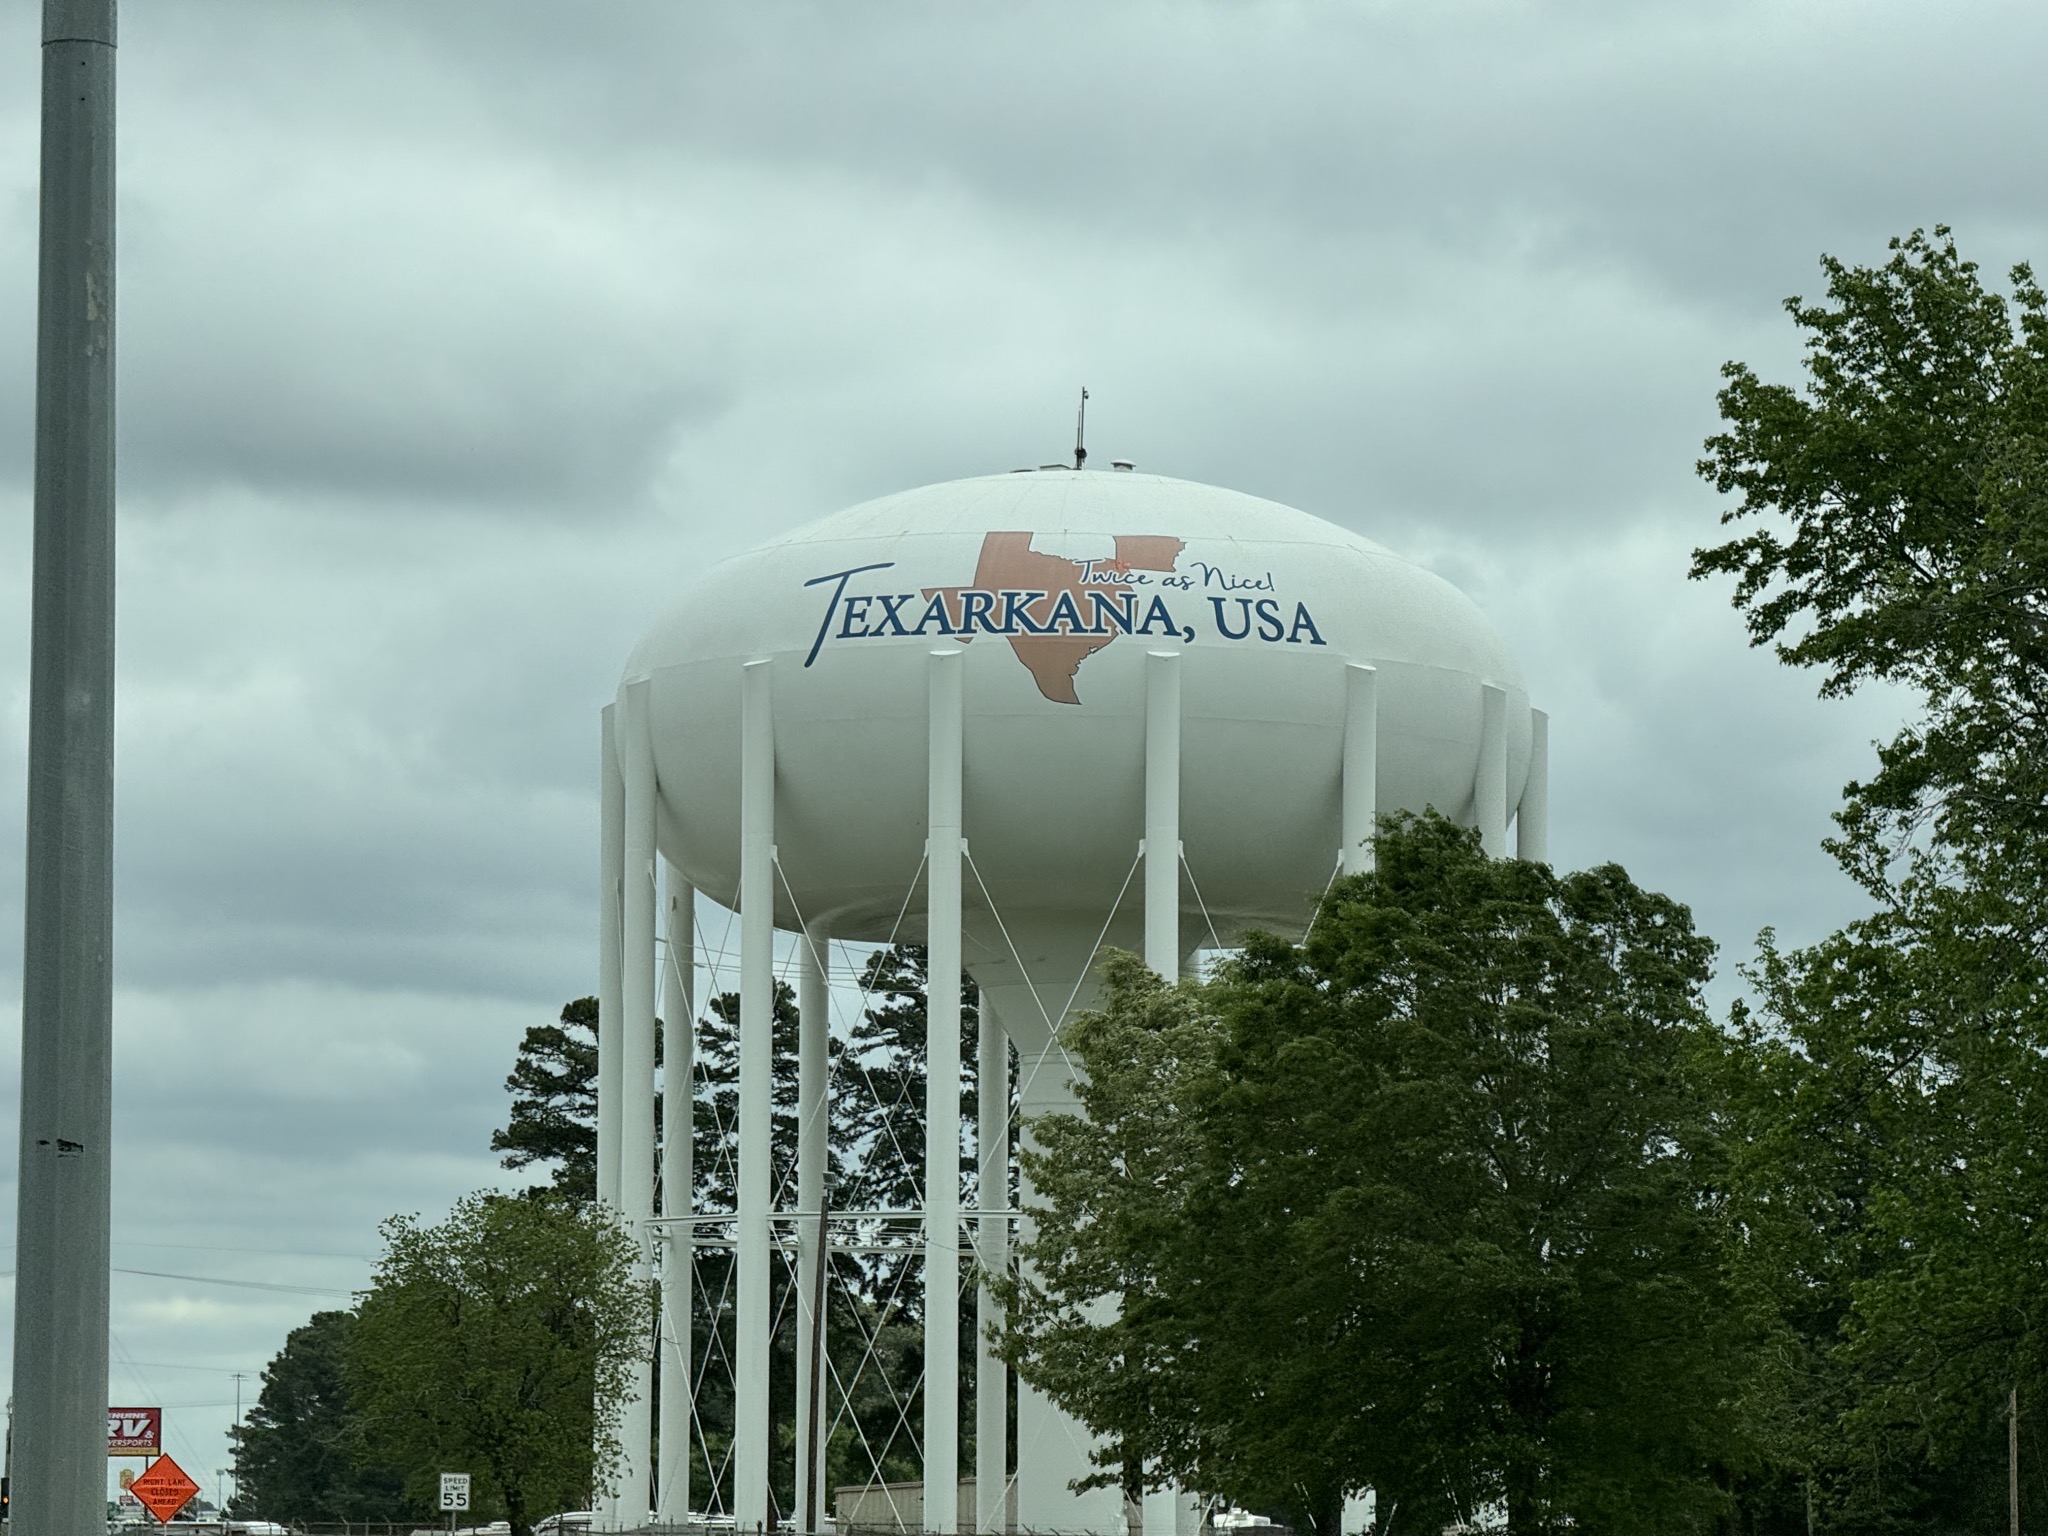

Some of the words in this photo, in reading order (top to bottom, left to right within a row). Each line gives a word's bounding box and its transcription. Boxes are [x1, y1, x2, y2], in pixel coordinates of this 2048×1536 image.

[1073, 558, 1153, 584] Twice
[1162, 574, 1195, 591] as
[1190, 562, 1275, 592] Nice!
[804, 562, 1196, 668] TEXARKANA,
[1207, 596, 1327, 646] USA
[144, 1430, 155, 1439] &
[143, 1478, 164, 1486] RIGHT
[168, 1478, 186, 1486] LANE
[151, 1487, 179, 1496] CLOSED
[443, 1493, 467, 1507] 55
